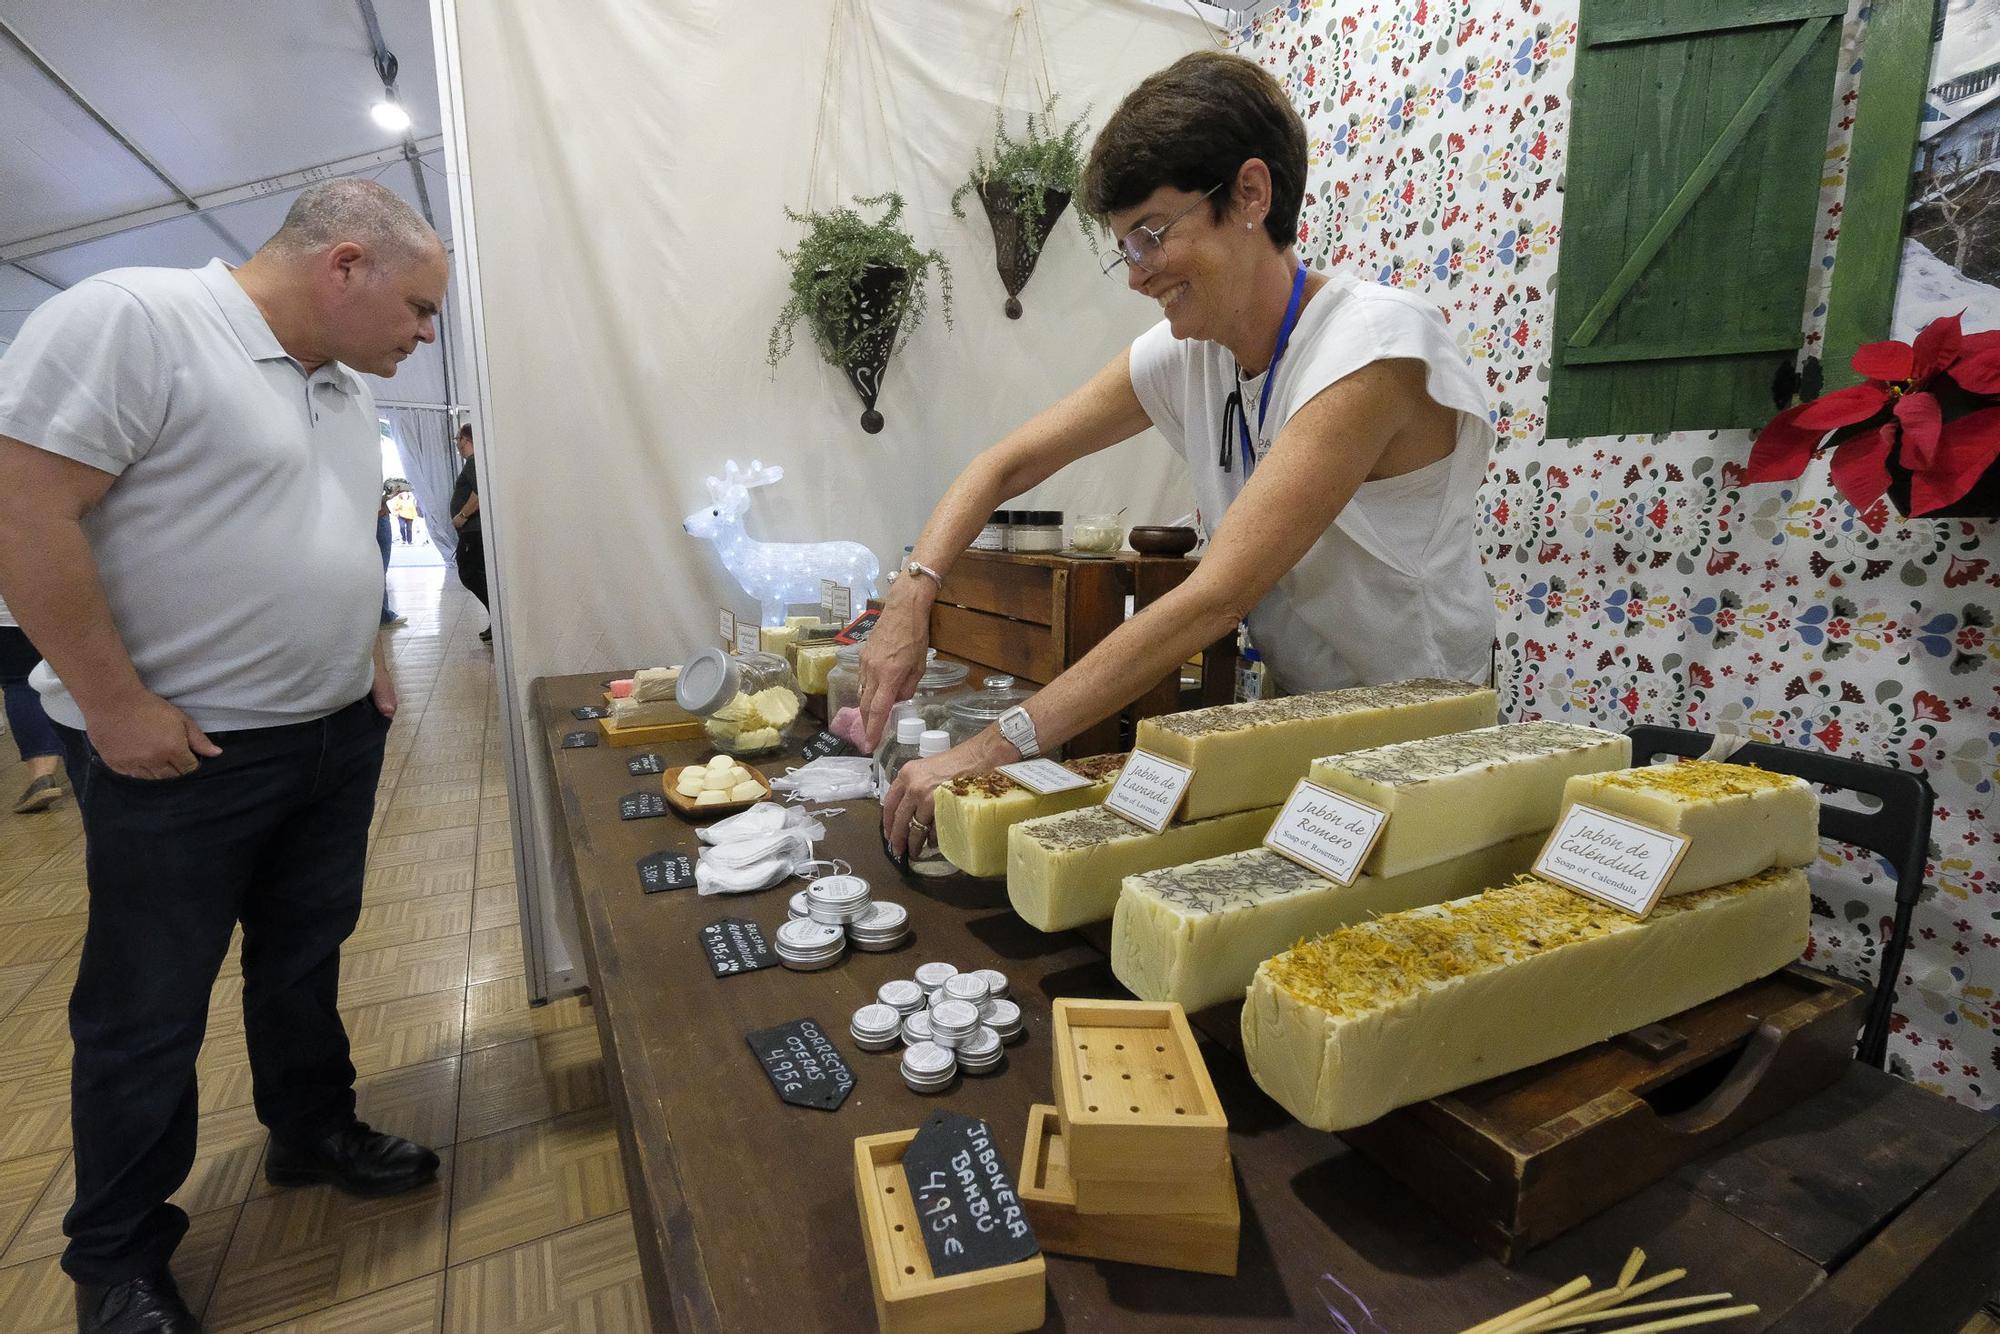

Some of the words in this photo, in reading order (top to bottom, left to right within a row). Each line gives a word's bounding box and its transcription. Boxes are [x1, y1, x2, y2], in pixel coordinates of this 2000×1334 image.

[1123, 778, 1169, 805] Lavanda
[1127, 766, 1160, 784] Jabón
[1160, 777, 1176, 790] de
[1296, 817, 1353, 849] Romero
[1297, 801, 1344, 826] Jabón
[1345, 819, 1367, 836] de
[1282, 830, 1299, 844] Soap
[1301, 838, 1309, 847] of
[1311, 843, 1348, 867] Rosemary
[1560, 839, 1649, 880] Caléndula
[1570, 826, 1624, 850] Jabón
[1625, 843, 1650, 860] de
[1554, 856, 1576, 871] Soap
[1577, 866, 1589, 875] of
[1591, 871, 1638, 895] Calendula
[786, 1036, 826, 1080] OJERAS
[800, 1022, 852, 1092] CORRECTOR
[966, 1123, 1028, 1239] JABONERA
